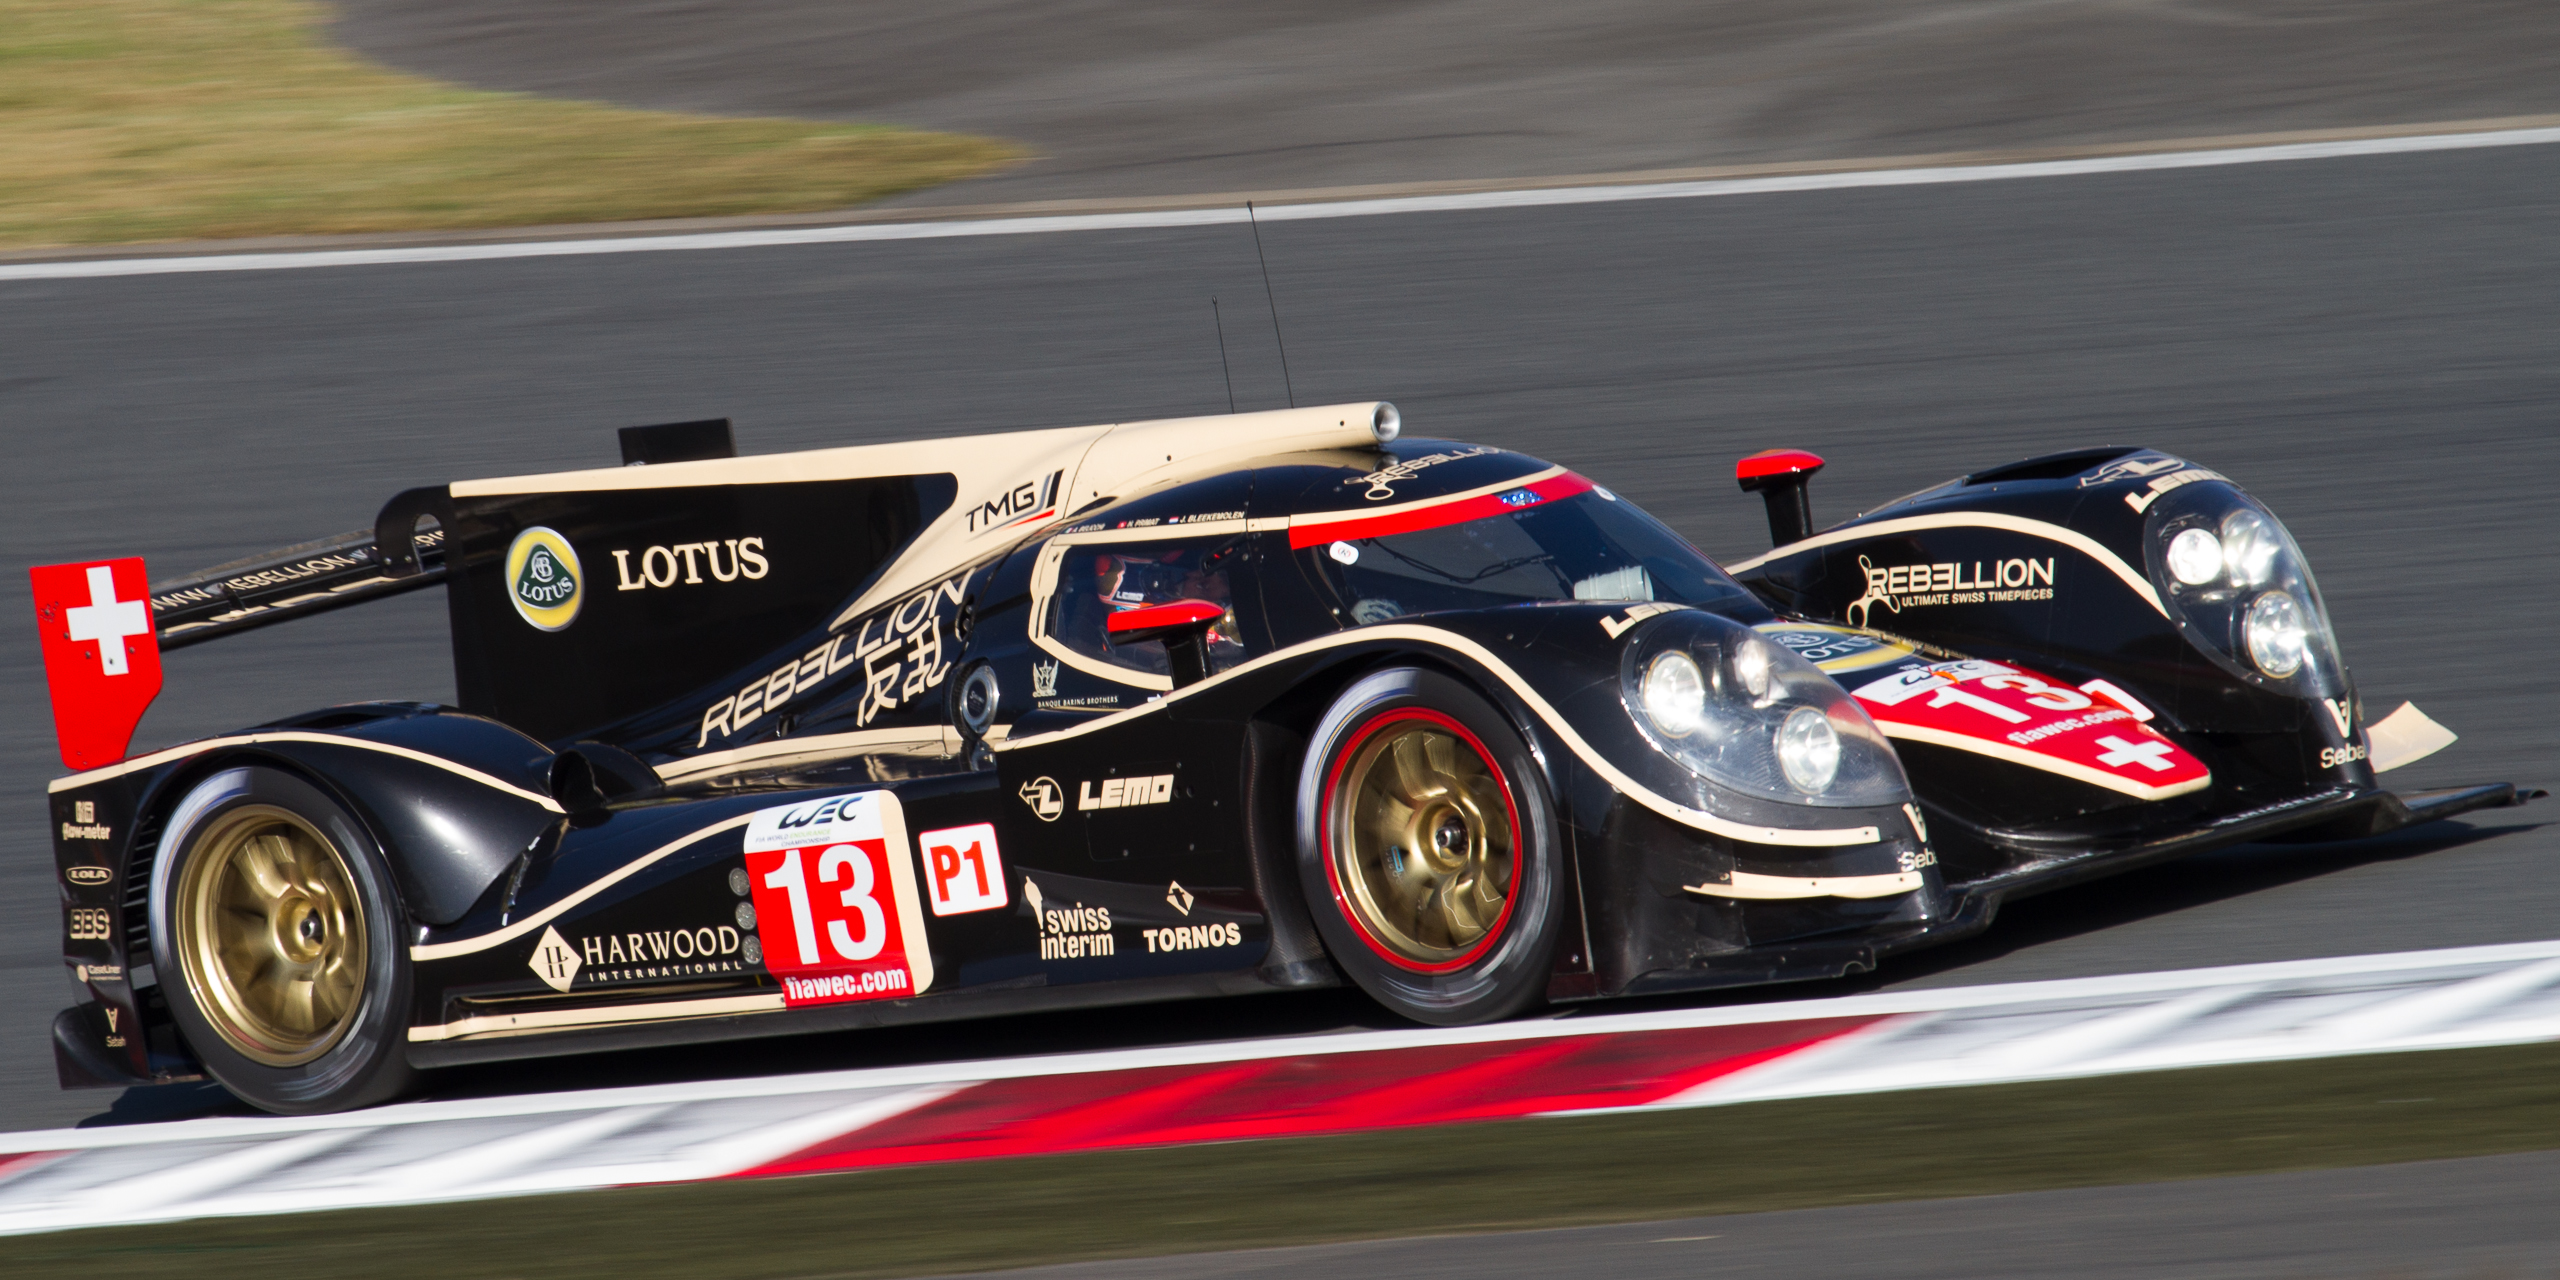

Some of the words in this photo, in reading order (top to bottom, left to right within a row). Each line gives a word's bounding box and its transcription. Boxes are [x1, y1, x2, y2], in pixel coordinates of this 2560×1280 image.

[965, 480, 1035, 532] TMG
[1187, 510, 1245, 523] BLEEKEMOLEN
[611, 536, 769, 591] LOTUS
[1867, 557, 2055, 596] REBELLION
[520, 576, 573, 601] LOTUS
[1902, 594, 1949, 607] ULTIMATE
[1951, 592, 1986, 604] SWISS
[1988, 588, 2054, 602] TIMEPIECES
[697, 566, 978, 749] REBELLION
[1037, 699, 1061, 709] BANQUE
[1086, 694, 1119, 706] BROTHERS
[1926, 673, 2093, 724] 13
[2006, 709, 2133, 746] fiawec.com
[1078, 774, 1175, 811] LEMO
[777, 796, 864, 829] WEC
[767, 834, 789, 843] WORLD
[789, 829, 832, 840] ENDURANCE
[781, 836, 831, 848] CHAMPIONSHIP
[70, 869, 108, 879] LOLA
[929, 840, 991, 903] P1
[764, 844, 887, 965] 13
[70, 908, 111, 940] BBS
[1143, 922, 1242, 953] TORNOS
[582, 925, 740, 966] HARWOOD
[1040, 931, 1115, 960] interim
[588, 960, 742, 983] INTERNATIONAL
[784, 968, 908, 1000] fiawec.com
